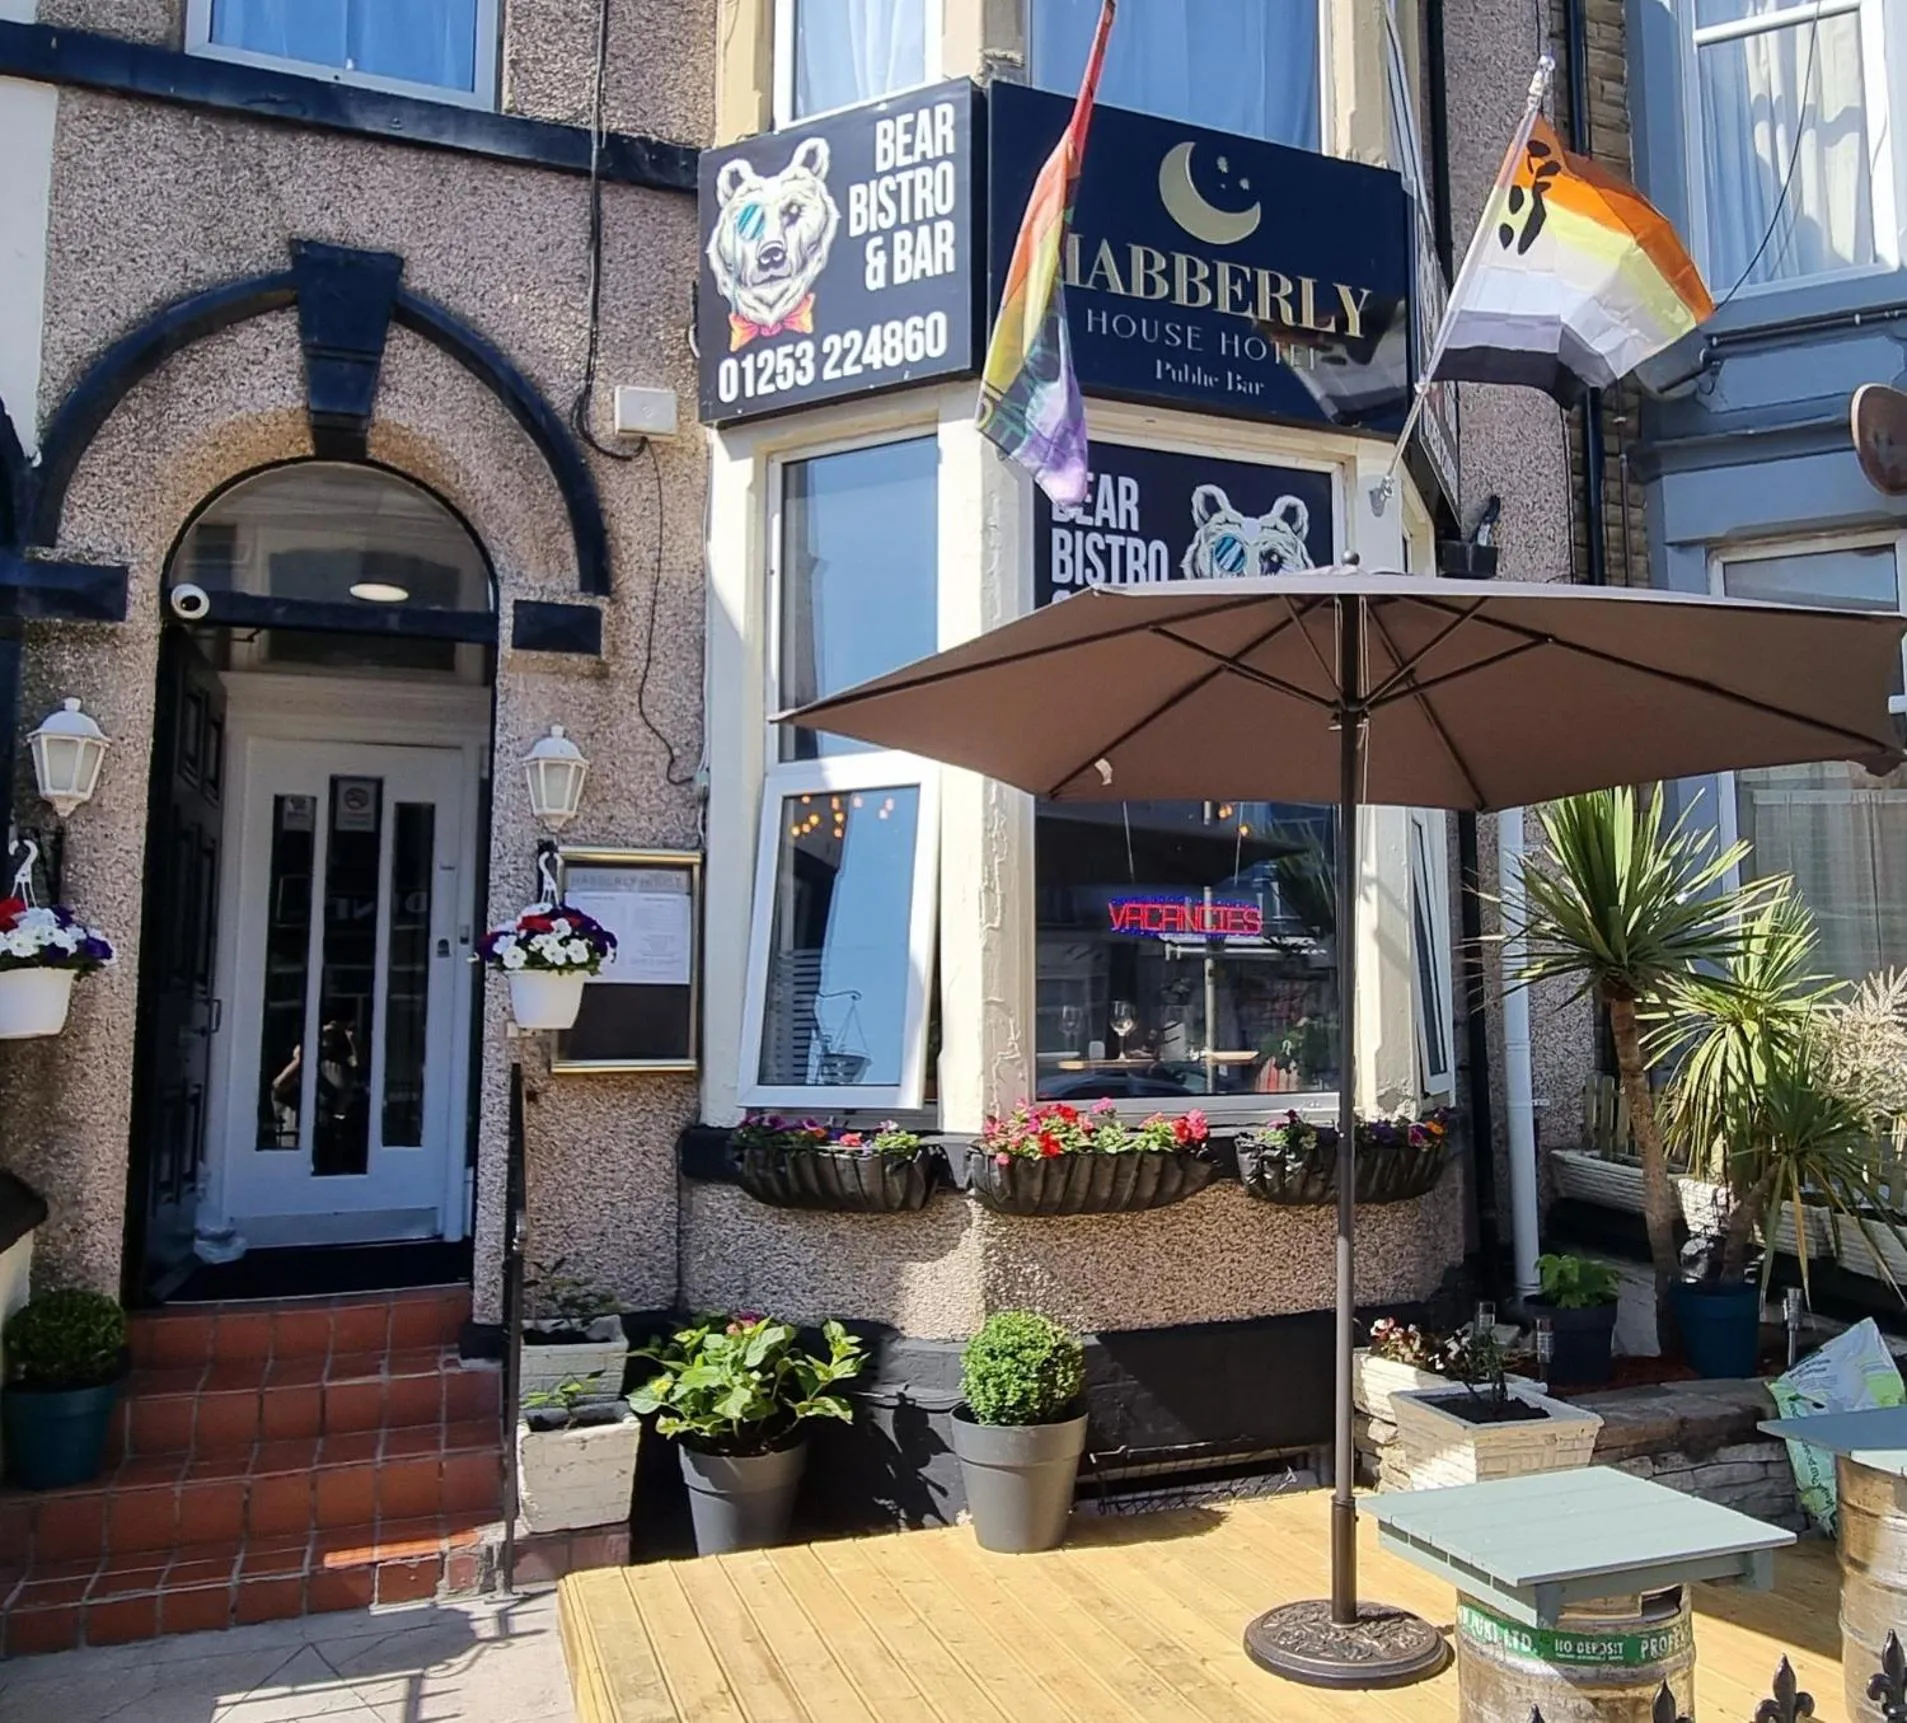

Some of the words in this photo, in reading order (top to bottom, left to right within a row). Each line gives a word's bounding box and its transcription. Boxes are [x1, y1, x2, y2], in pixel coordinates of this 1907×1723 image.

[875, 103, 955, 173] BEAR
[849, 161, 954, 237] BISTRO
[864, 236, 887, 291] &
[893, 220, 955, 284] BAR
[718, 341, 815, 402] 01253
[822, 311, 947, 380] 224860
[1088, 309, 1204, 350] HOUSE
[1156, 359, 1219, 388] Public
[1227, 370, 1265, 396] Bar
[1052, 472, 1140, 532] EAR
[1052, 528, 1169, 585] BISTRO
[1108, 902, 1262, 934] VACANCIES
[1555, 1638, 1573, 1653] NO
[1576, 1641, 1624, 1655] DEPOSIT
